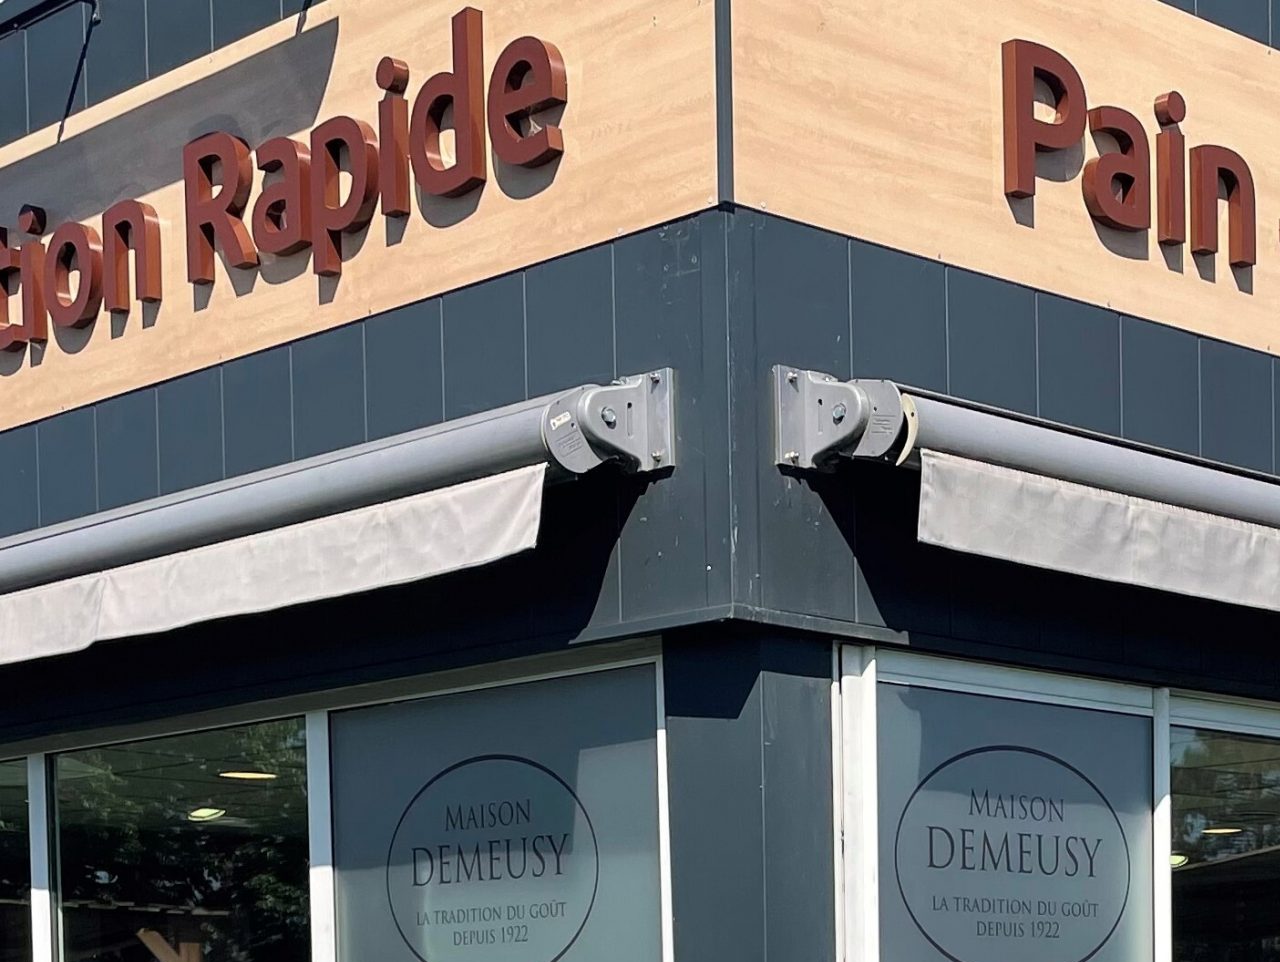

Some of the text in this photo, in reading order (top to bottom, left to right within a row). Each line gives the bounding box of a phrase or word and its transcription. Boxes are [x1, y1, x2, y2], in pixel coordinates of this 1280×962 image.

[184, 7, 568, 285] Rapide
[1001, 38, 1256, 267] Pain
[445, 799, 531, 832] MAISON
[968, 788, 1064, 822] MAISON
[411, 833, 569, 887] DEMEUSY
[926, 825, 1103, 878] DEMEUSY
[416, 899, 567, 926] LA TRADITION DU GOÛT
[932, 895, 1099, 918] LA TRADITION DU GOÛT
[453, 925, 528, 946] DEPUIS 1922
[976, 921, 1060, 939] DEPUIS 1922
